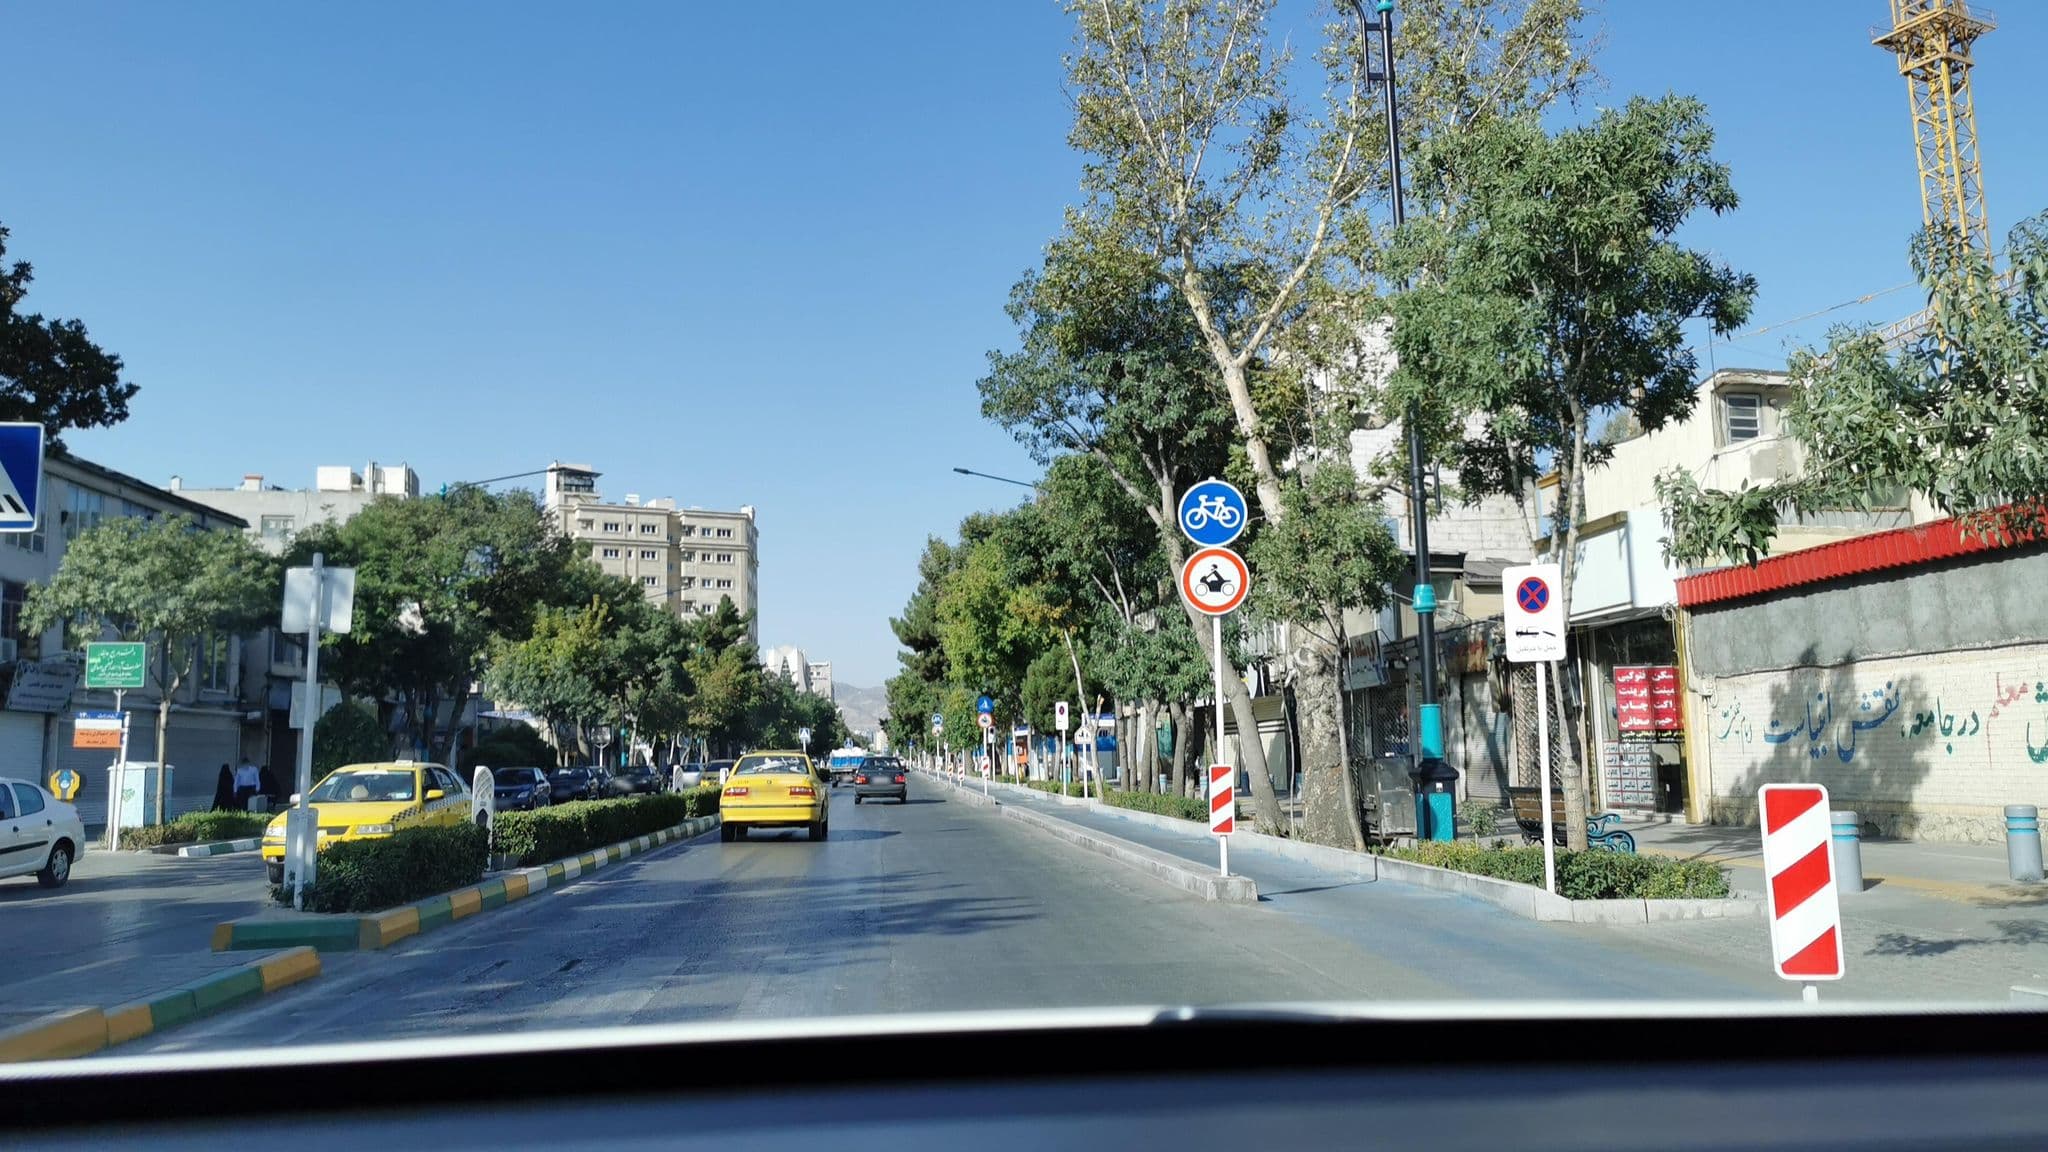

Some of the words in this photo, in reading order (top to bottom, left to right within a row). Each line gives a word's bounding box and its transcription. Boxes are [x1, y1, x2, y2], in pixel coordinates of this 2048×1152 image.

[1651, 669, 1674, 681] سکن
[1837, 681, 1900, 764] نقش
[1956, 710, 1980, 737] در
